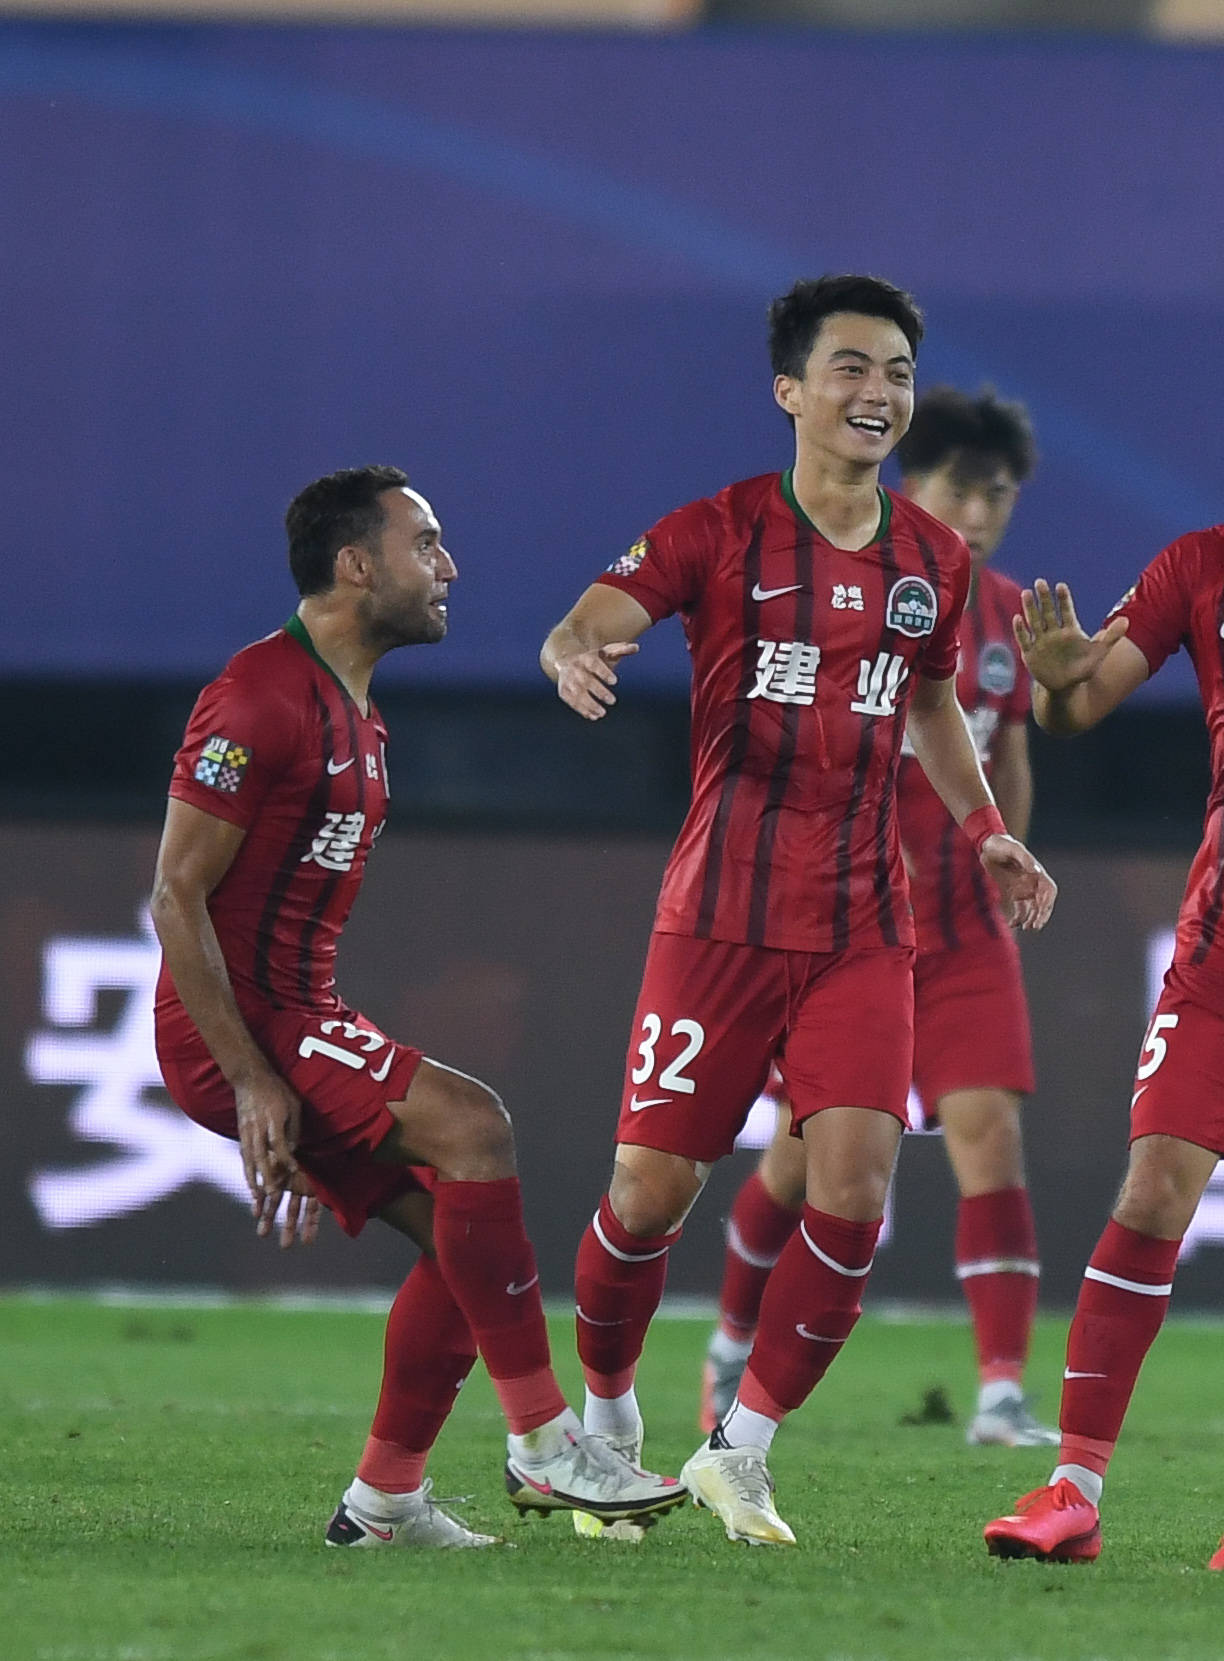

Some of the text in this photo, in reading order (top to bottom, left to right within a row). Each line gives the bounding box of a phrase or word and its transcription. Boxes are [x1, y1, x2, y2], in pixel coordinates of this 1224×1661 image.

[747, 640, 909, 716] 建业
[300, 811, 386, 872] 建
[299, 1020, 385, 1071] 13
[631, 1012, 705, 1095] 32
[1137, 1013, 1179, 1081] 5
